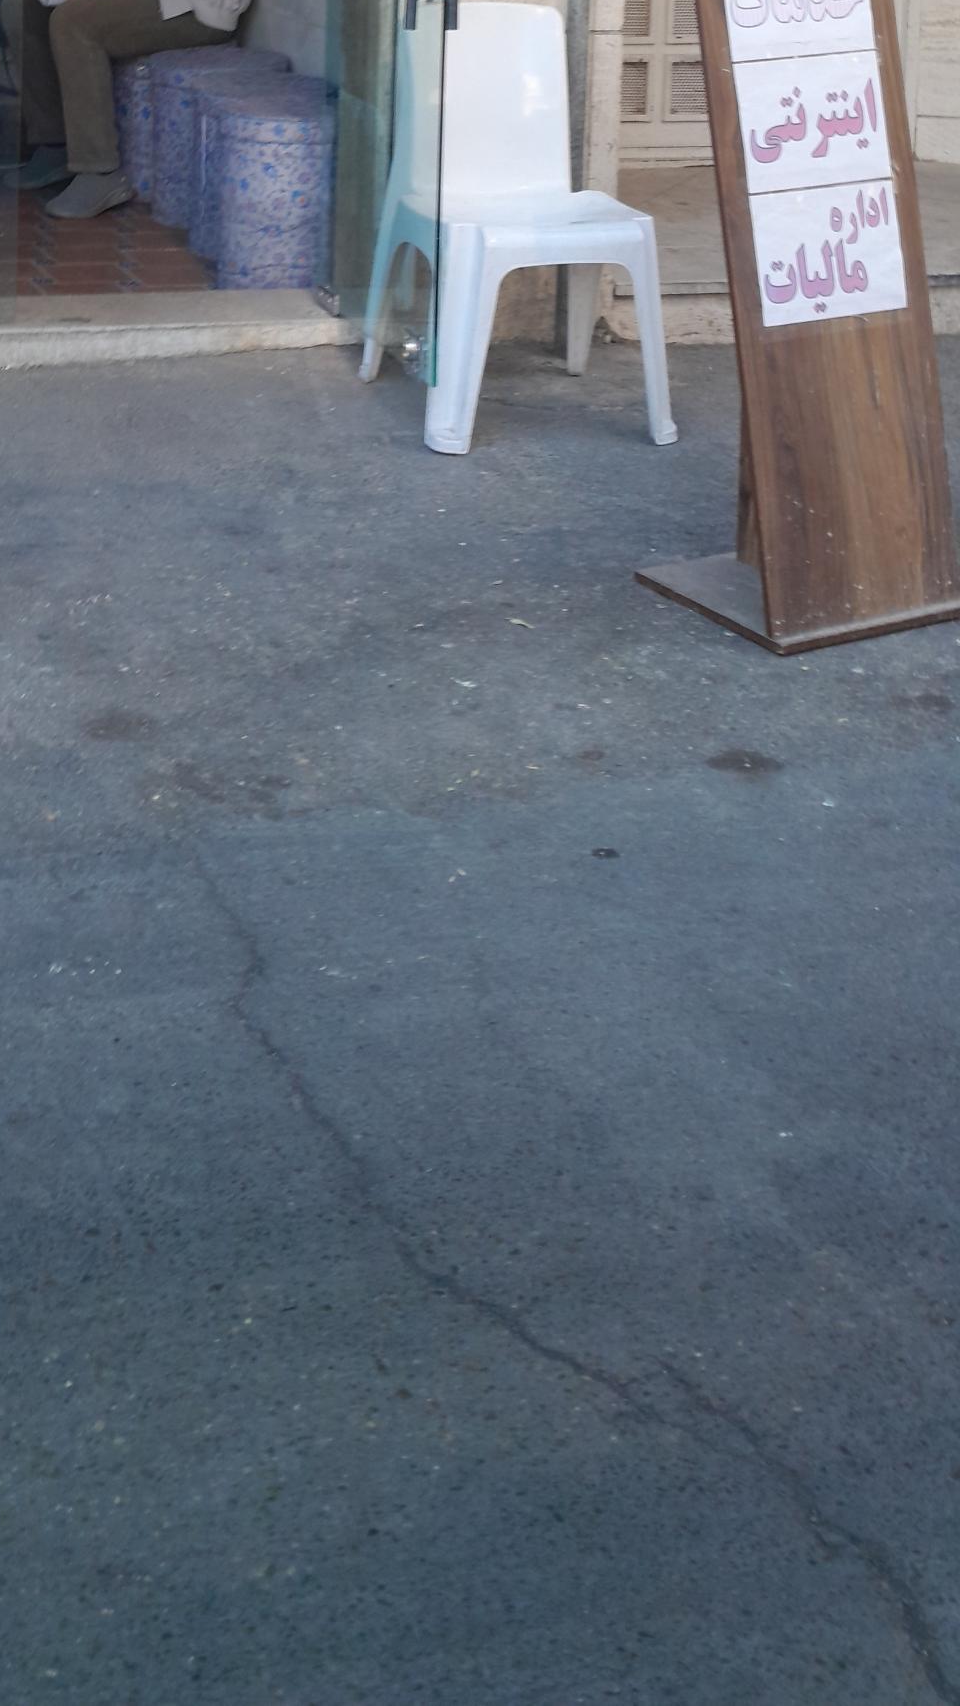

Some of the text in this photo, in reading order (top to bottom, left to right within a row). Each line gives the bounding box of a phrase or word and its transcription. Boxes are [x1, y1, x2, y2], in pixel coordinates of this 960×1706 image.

[750, 77, 879, 165] اینترنتی
[829, 187, 889, 245] اداره
[763, 238, 869, 315] مالیات
